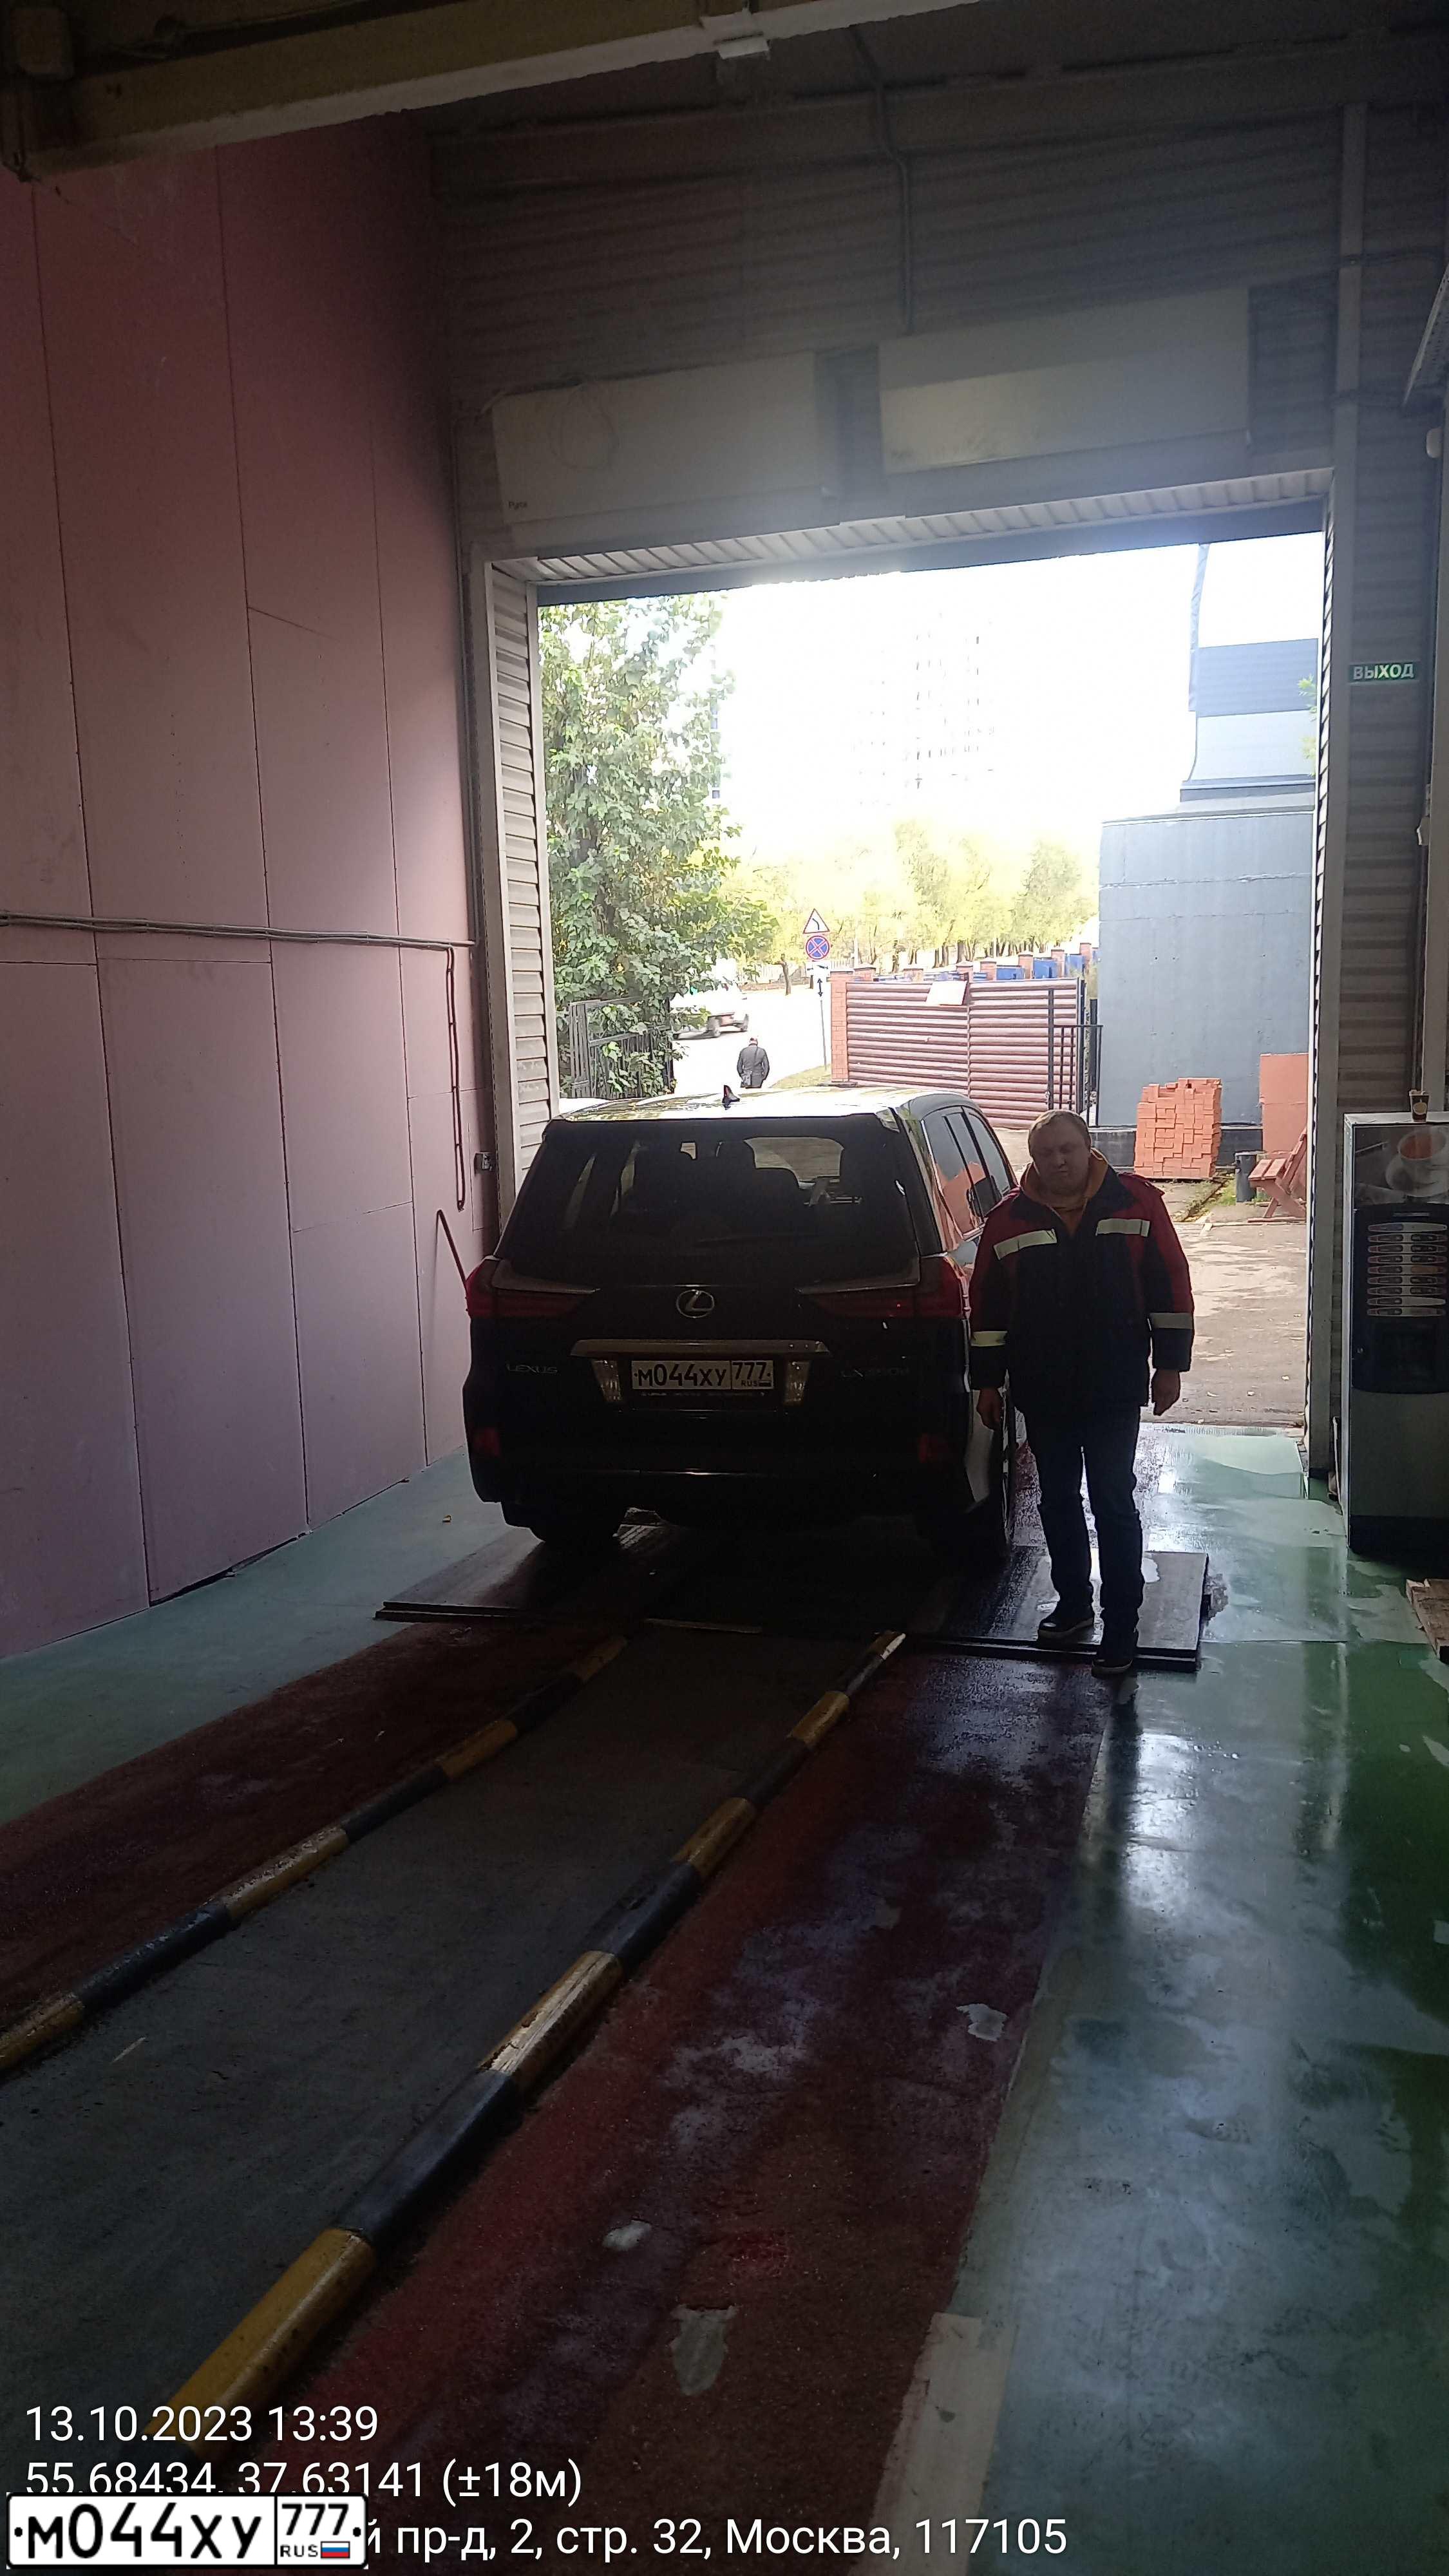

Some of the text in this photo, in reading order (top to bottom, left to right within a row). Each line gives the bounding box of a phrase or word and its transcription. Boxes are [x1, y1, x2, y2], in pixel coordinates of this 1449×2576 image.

[1353, 663, 1415, 680] ВЫХОД
[506, 1363, 558, 1374] LEXUS
[638, 1362, 767, 1386] М044ХУ 777
